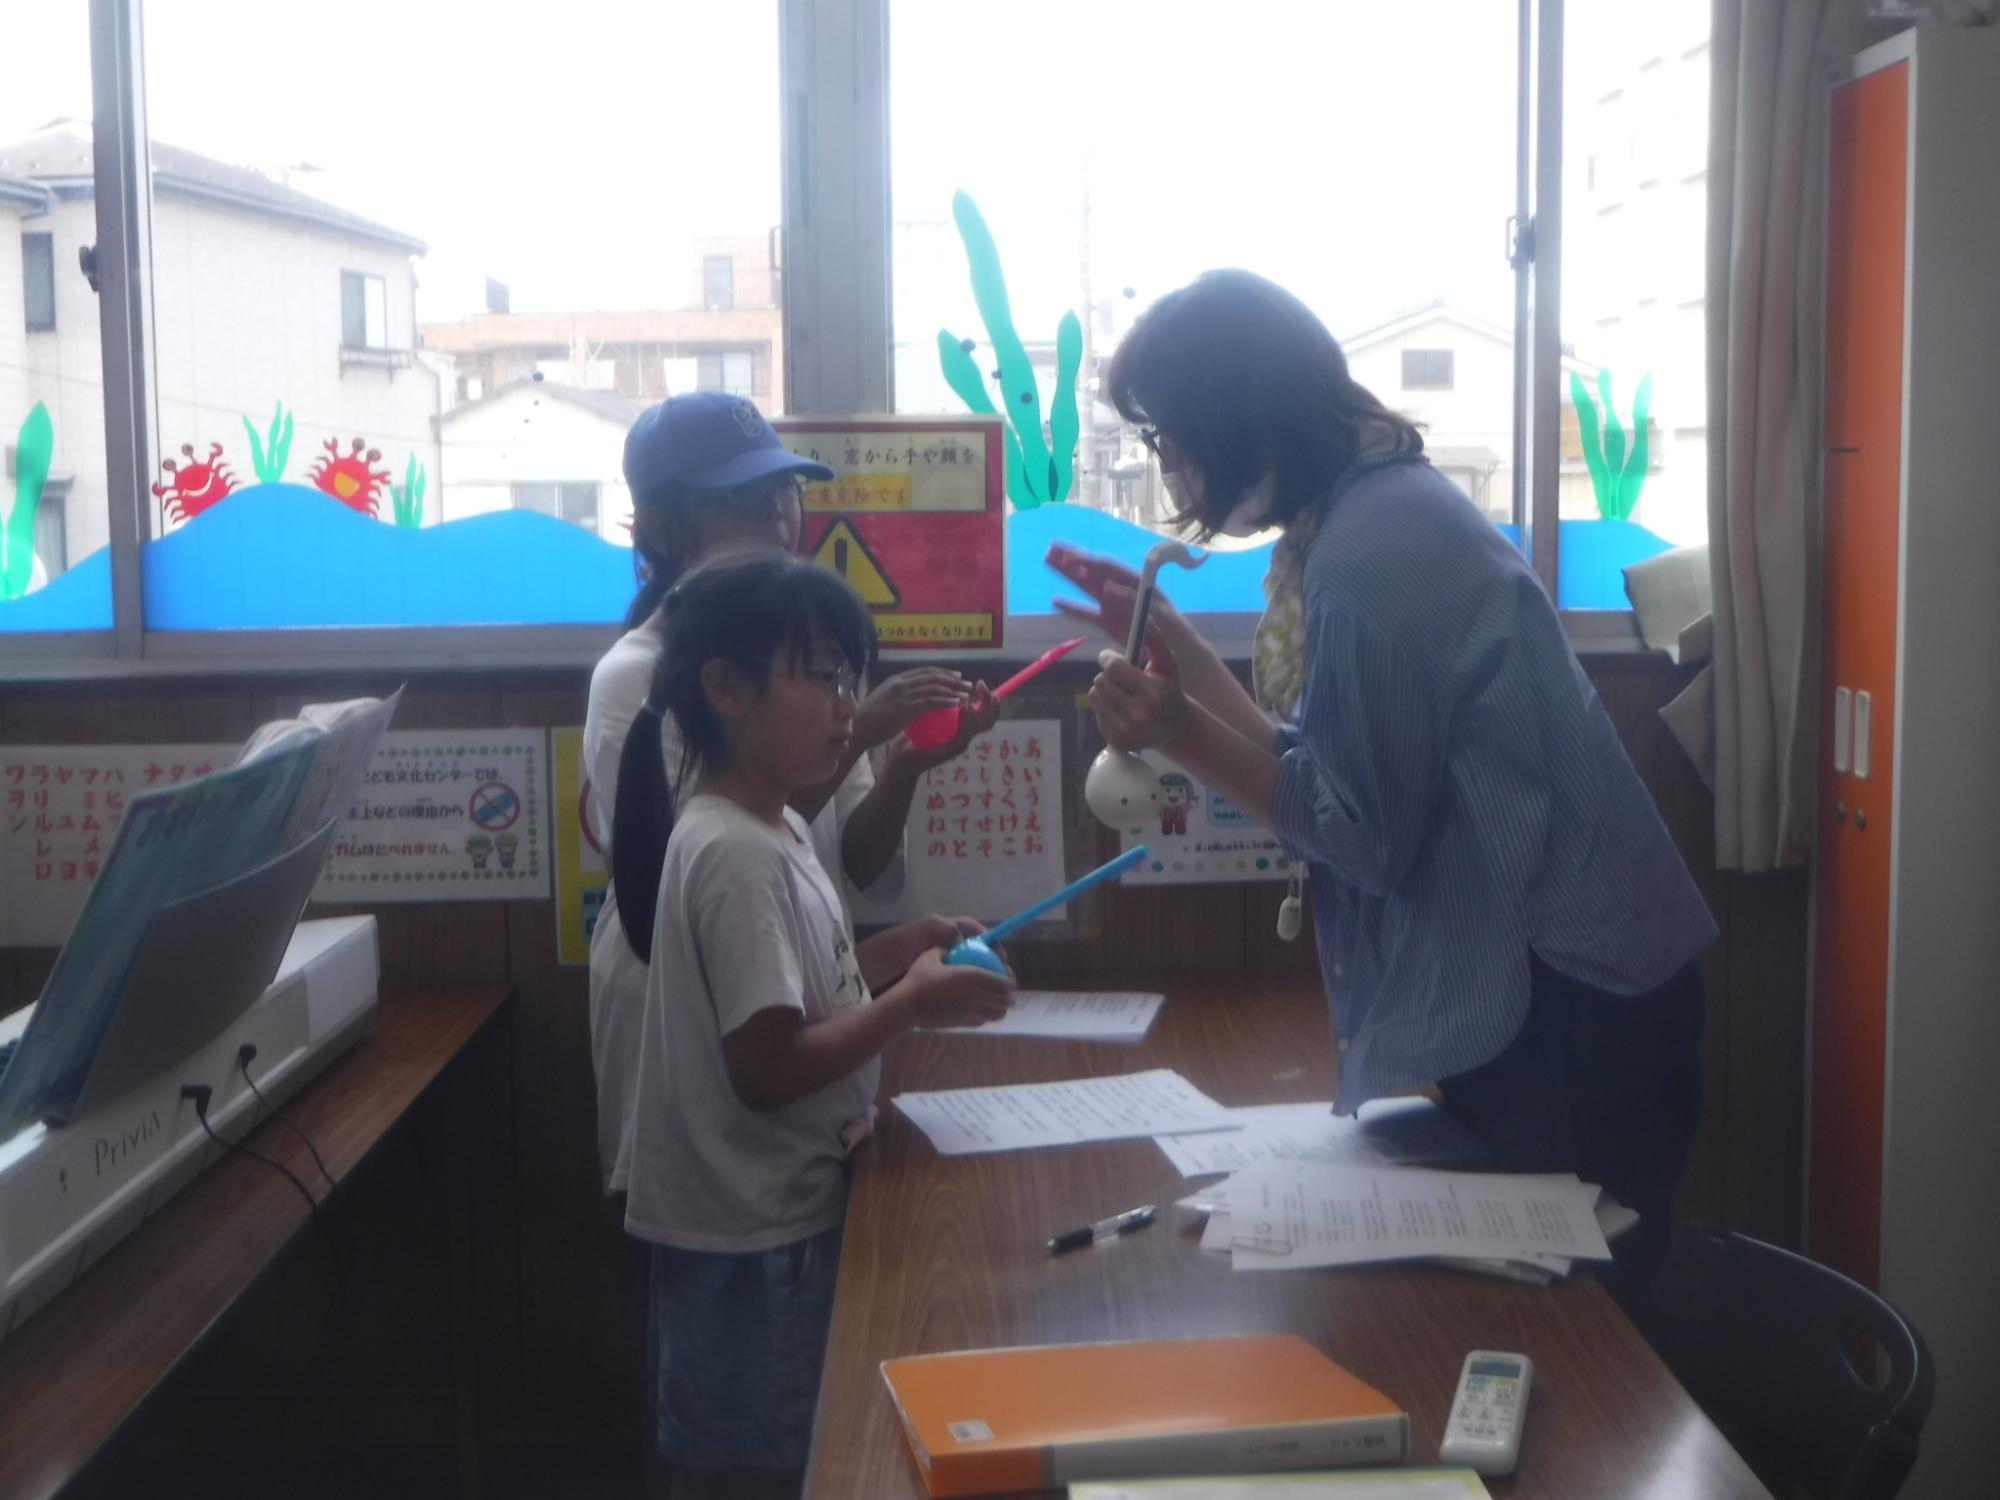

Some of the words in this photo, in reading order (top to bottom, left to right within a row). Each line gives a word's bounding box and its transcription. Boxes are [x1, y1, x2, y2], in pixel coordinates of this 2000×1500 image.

[793, 447, 974, 465] り、窓から手や顔を
[950, 754, 971, 859] ちつてと
